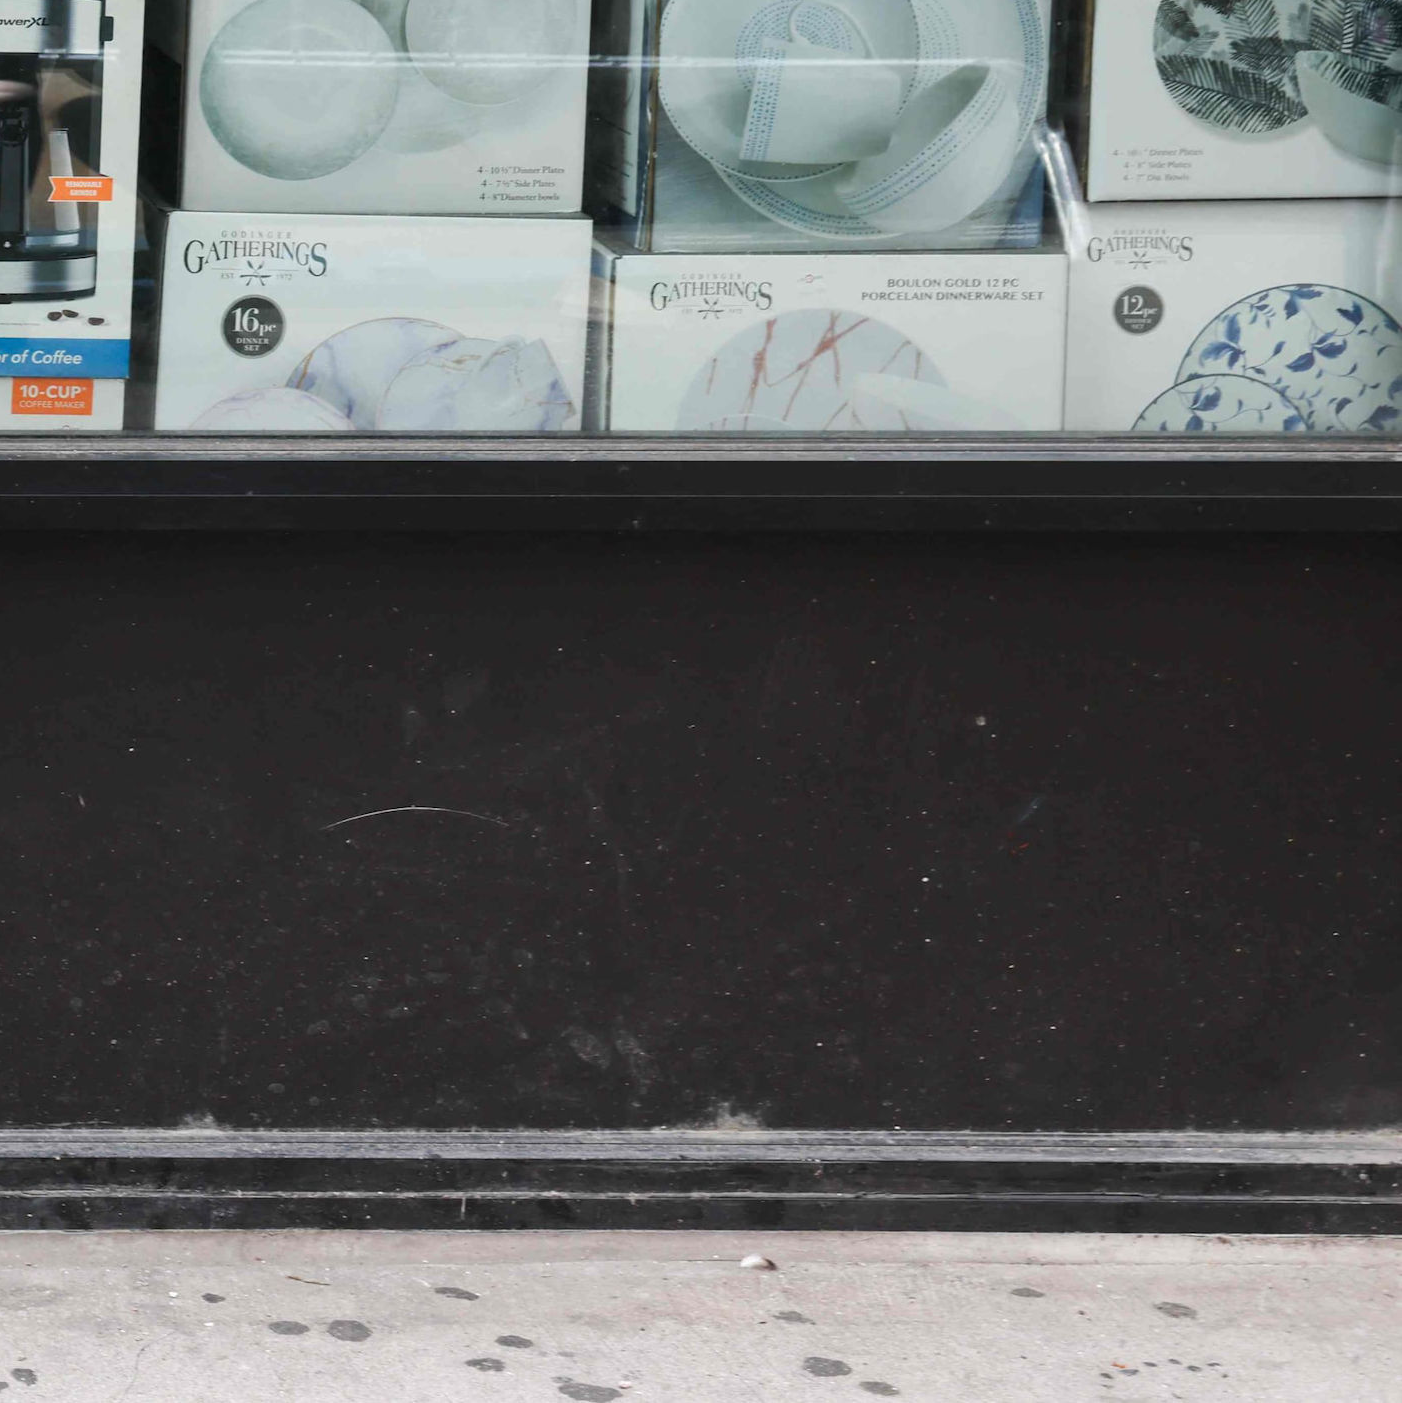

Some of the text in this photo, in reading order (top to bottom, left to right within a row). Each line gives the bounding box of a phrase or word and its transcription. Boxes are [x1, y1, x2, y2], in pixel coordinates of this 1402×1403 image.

[1087, 236, 1193, 263] GATHERINGS
[184, 239, 327, 277] GATHERINGS
[887, 278, 1020, 288] BOULON GOLD 12 PC
[650, 281, 773, 311] GATHERINGS
[861, 291, 1044, 301] PORCELAIN DINNERWARE SET
[11, 350, 29, 364] of
[31, 350, 83, 365] Coffee
[19, 385, 82, 398] 10-CUP
